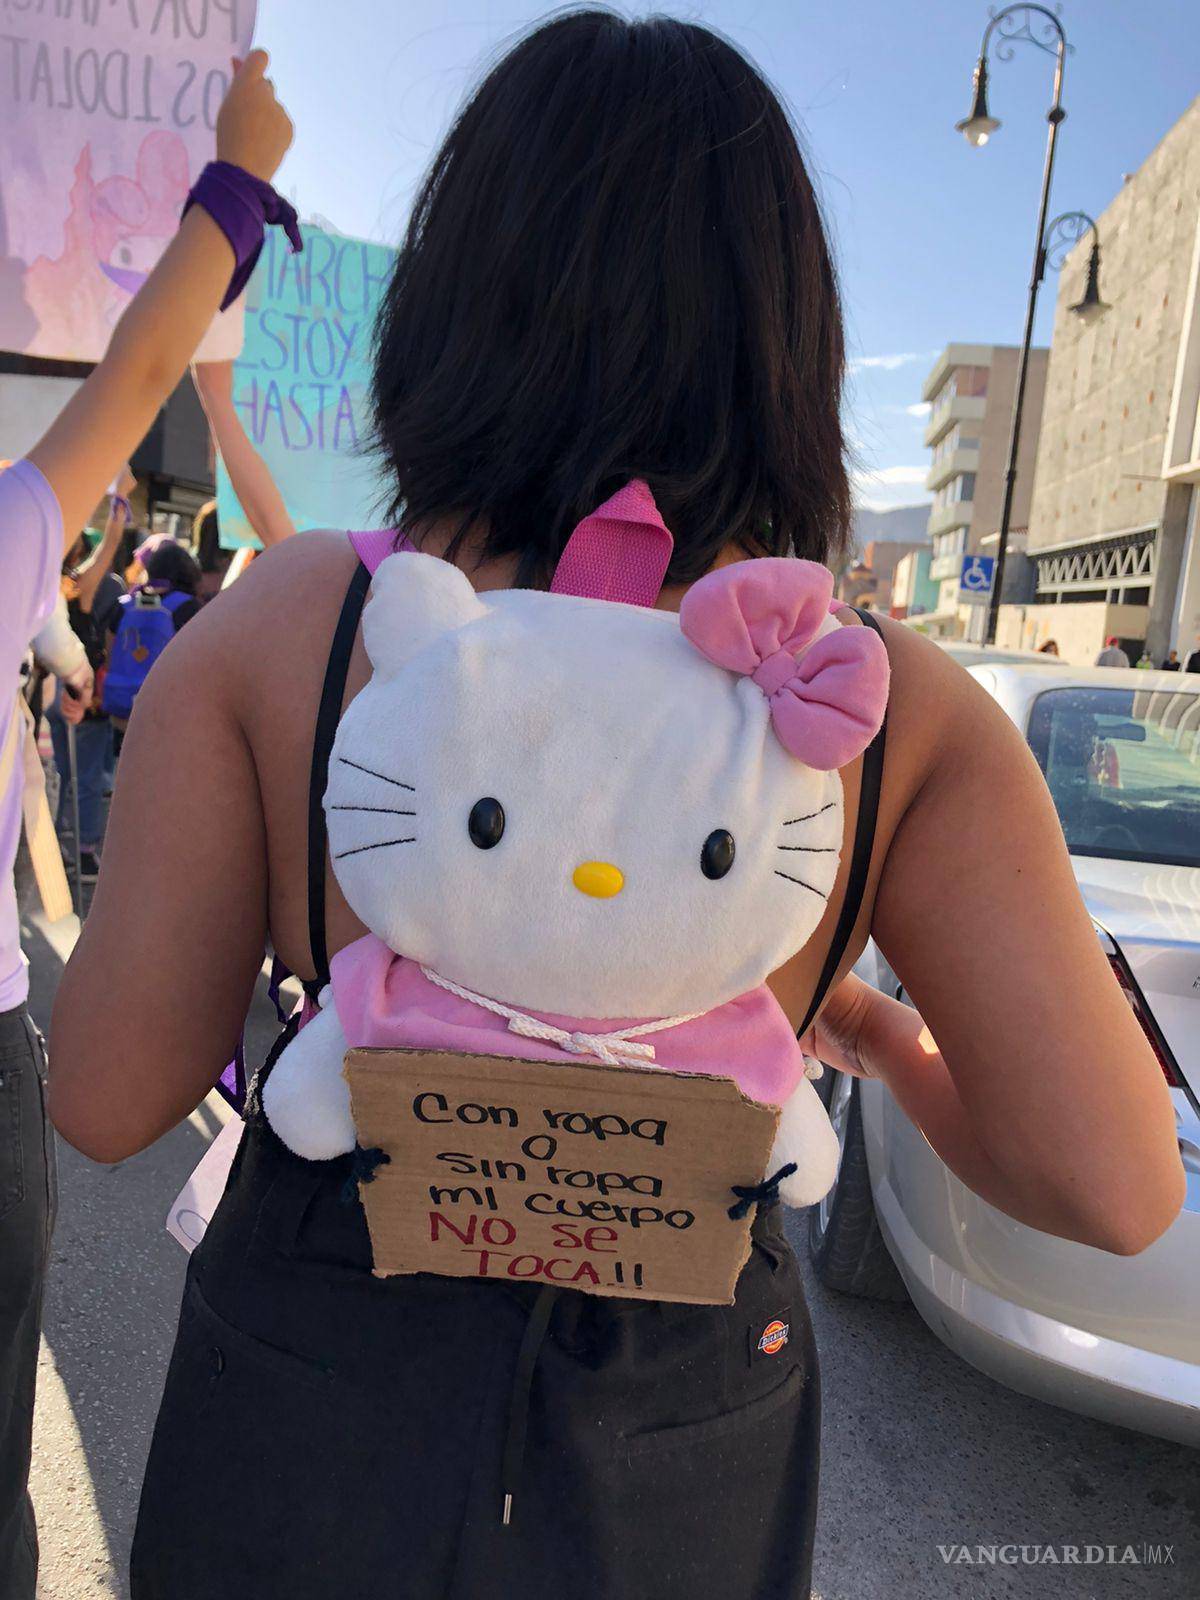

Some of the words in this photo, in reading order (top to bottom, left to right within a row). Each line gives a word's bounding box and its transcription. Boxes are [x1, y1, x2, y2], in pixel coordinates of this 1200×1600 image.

[266, 229, 395, 316] ARCH
[412, 1092, 519, 1128] Con
[542, 1108, 668, 1146] ropa
[546, 1165, 663, 1198] ropa
[429, 1211, 517, 1246] NO
[524, 1192, 696, 1230] cuerpo
